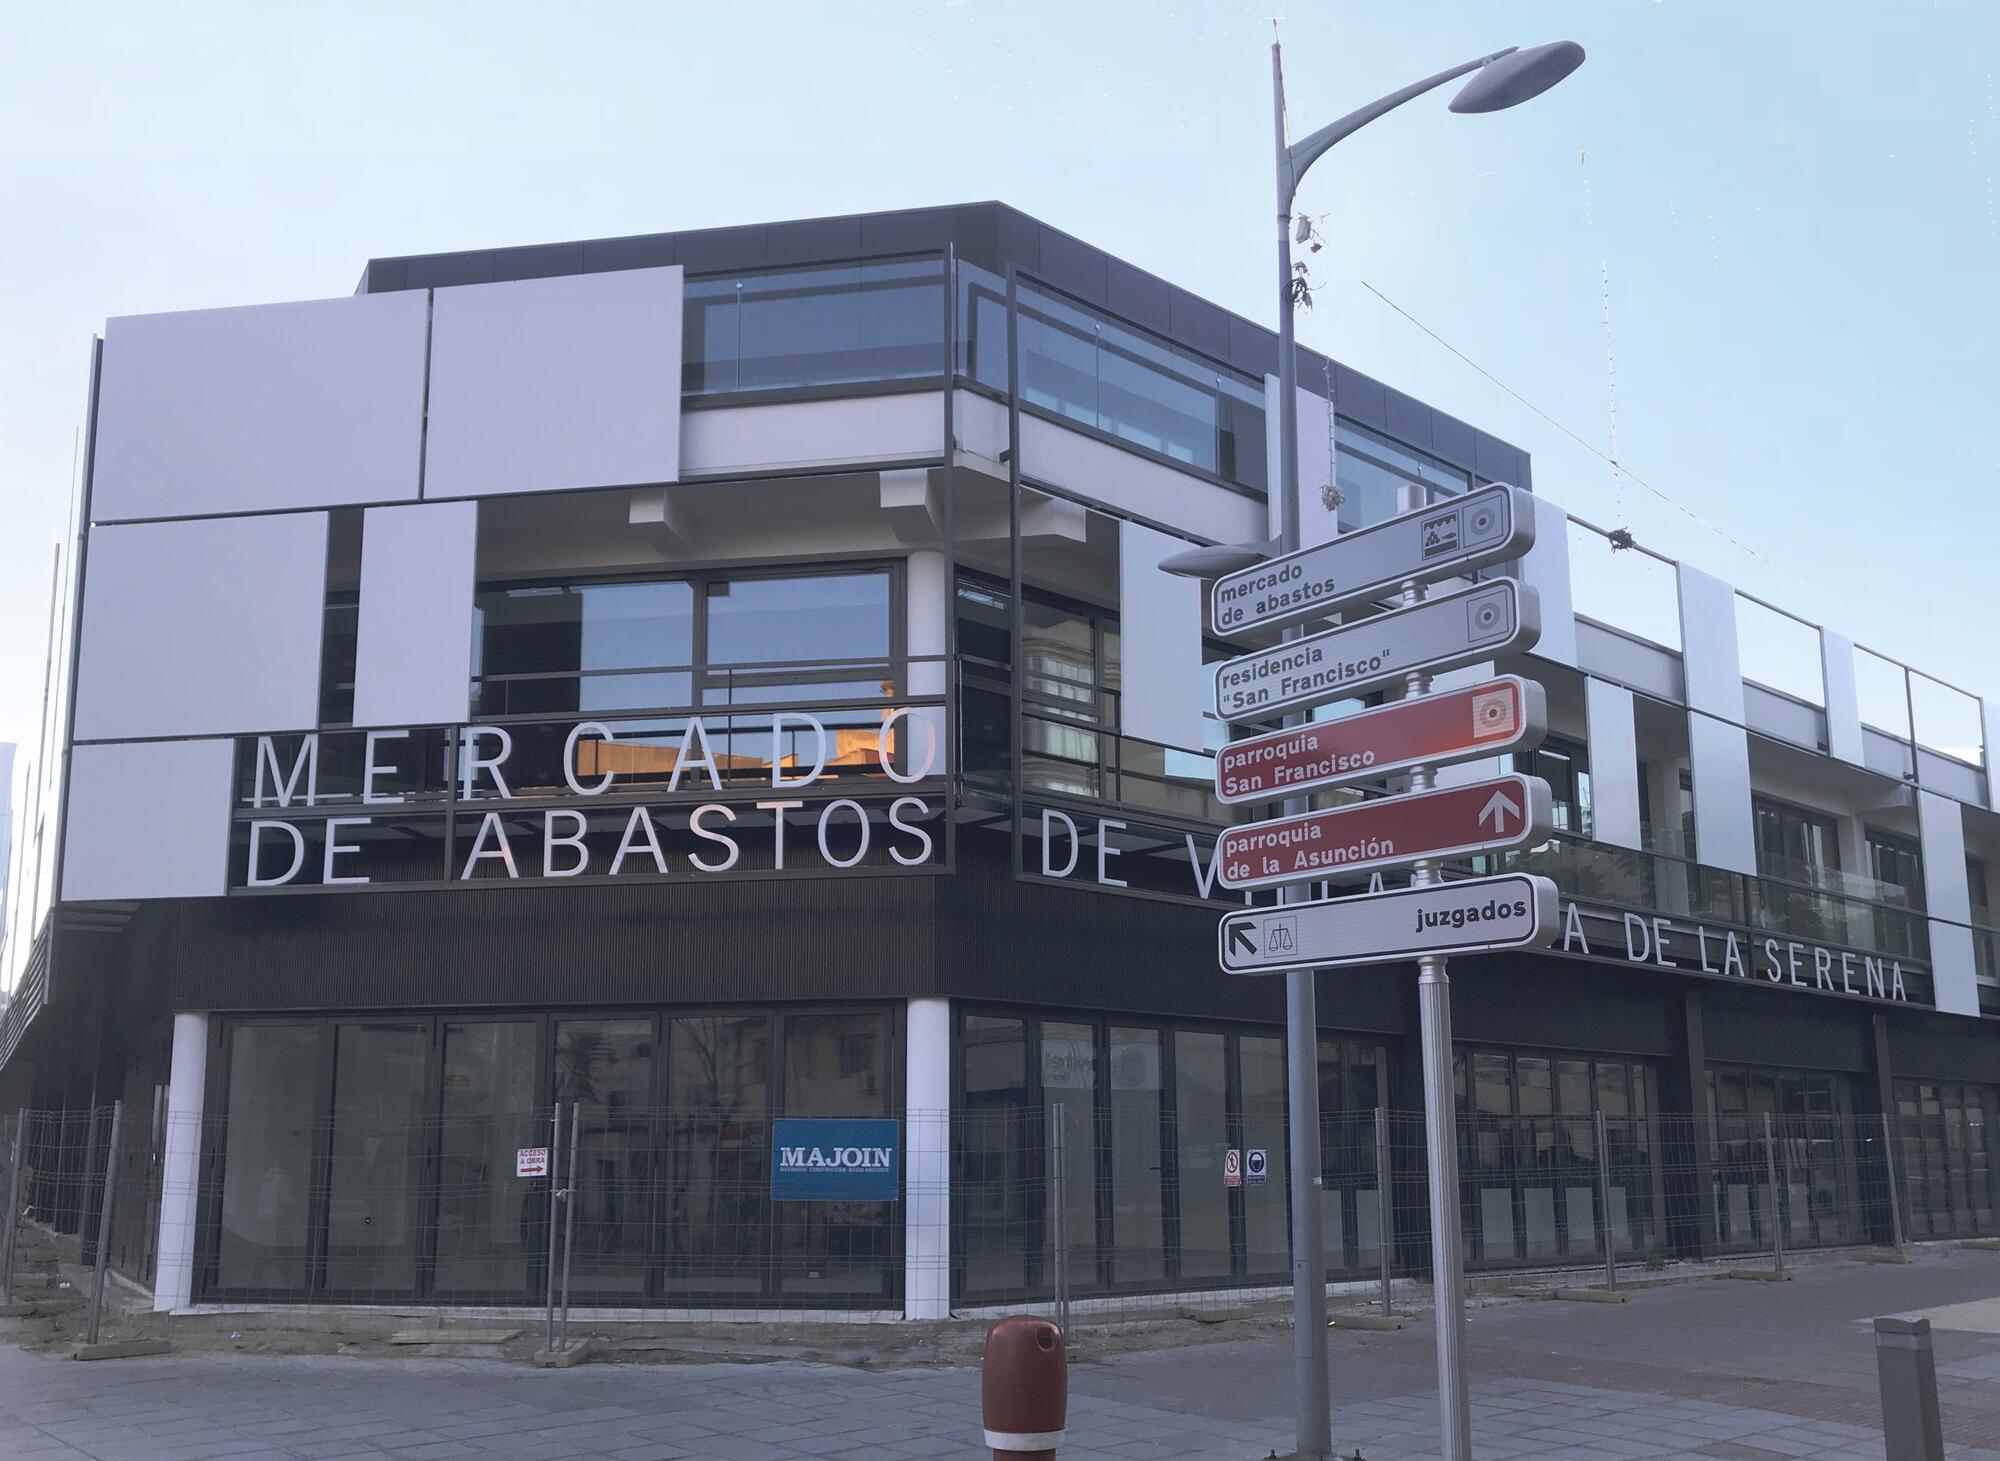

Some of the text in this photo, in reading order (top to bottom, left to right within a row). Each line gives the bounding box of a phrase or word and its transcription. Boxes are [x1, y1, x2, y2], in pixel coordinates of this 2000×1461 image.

[1221, 564, 1303, 603] mercado
[1222, 577, 1335, 627] de abastos
[1222, 647, 1323, 688] residencia
[1223, 649, 1390, 710] "San Francisco"
[253, 706, 937, 809] MERCADO
[1224, 735, 1319, 773] parroquia
[1226, 749, 1375, 795] San Francisco
[247, 797, 933, 887] DE ABASTOS
[1226, 824, 1322, 858] parroquia
[1227, 837, 1394, 880] de la Asunción
[1041, 808, 1129, 888] DE
[1624, 912, 1678, 967] DE
[1698, 925, 1745, 977] LA
[1765, 938, 1908, 1002] SERENA
[1416, 899, 1527, 932] juzgados
[520, 1149, 545, 1157] ACCESO
[780, 1147, 892, 1167] MAJOIN
